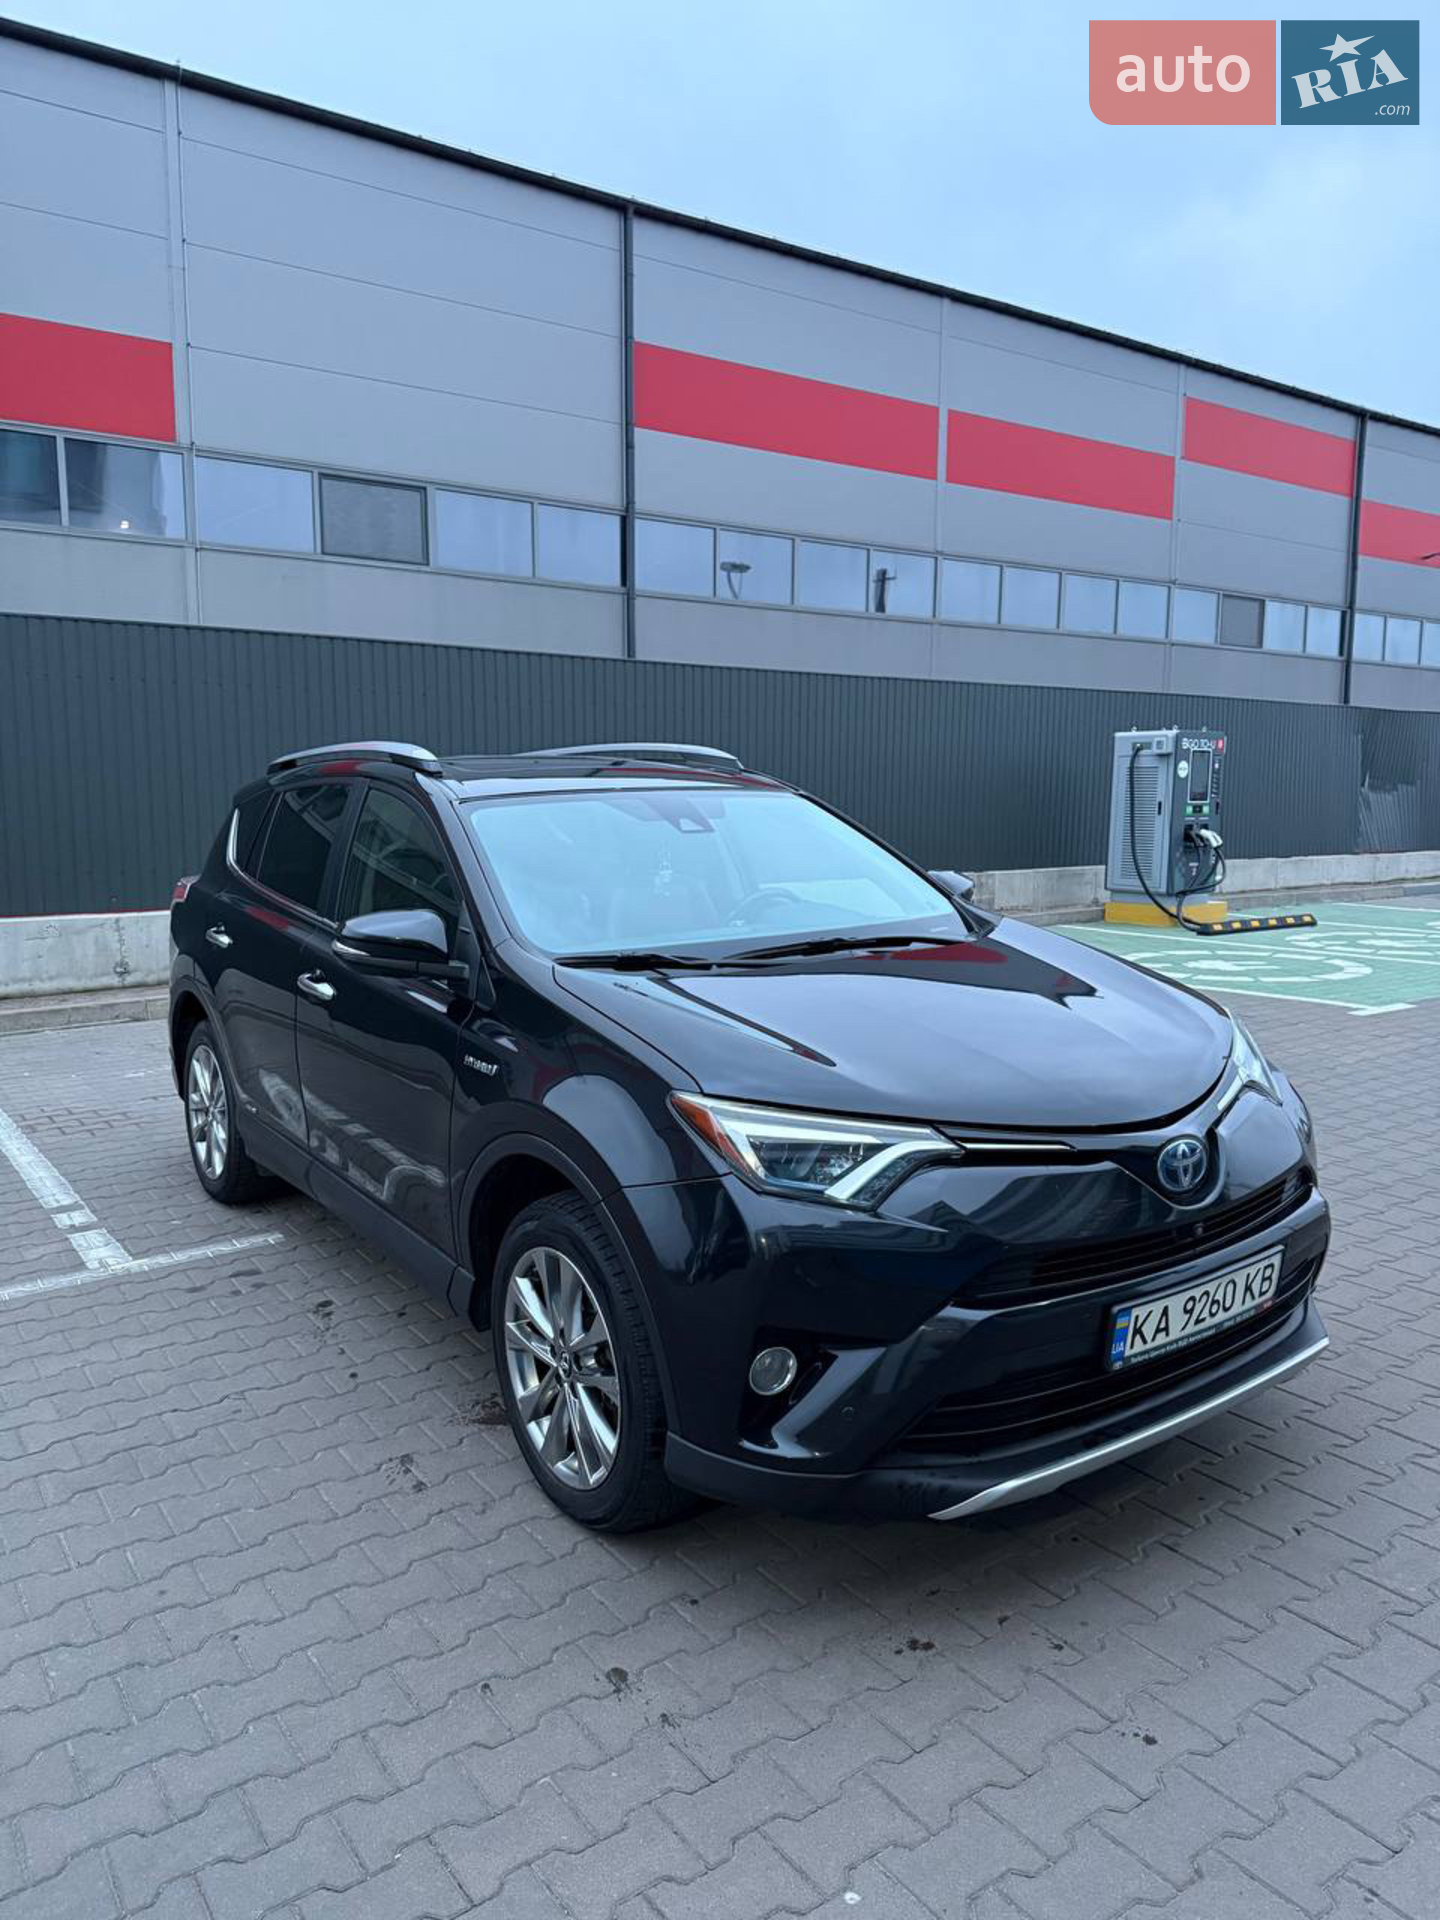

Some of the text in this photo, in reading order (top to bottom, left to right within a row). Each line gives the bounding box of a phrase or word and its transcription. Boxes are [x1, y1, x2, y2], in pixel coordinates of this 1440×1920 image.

[1129, 1305, 1170, 1350] KA
[1179, 1278, 1237, 1332] 9260
[1241, 1263, 1276, 1306] KB
[1111, 1341, 1124, 1354] UA
